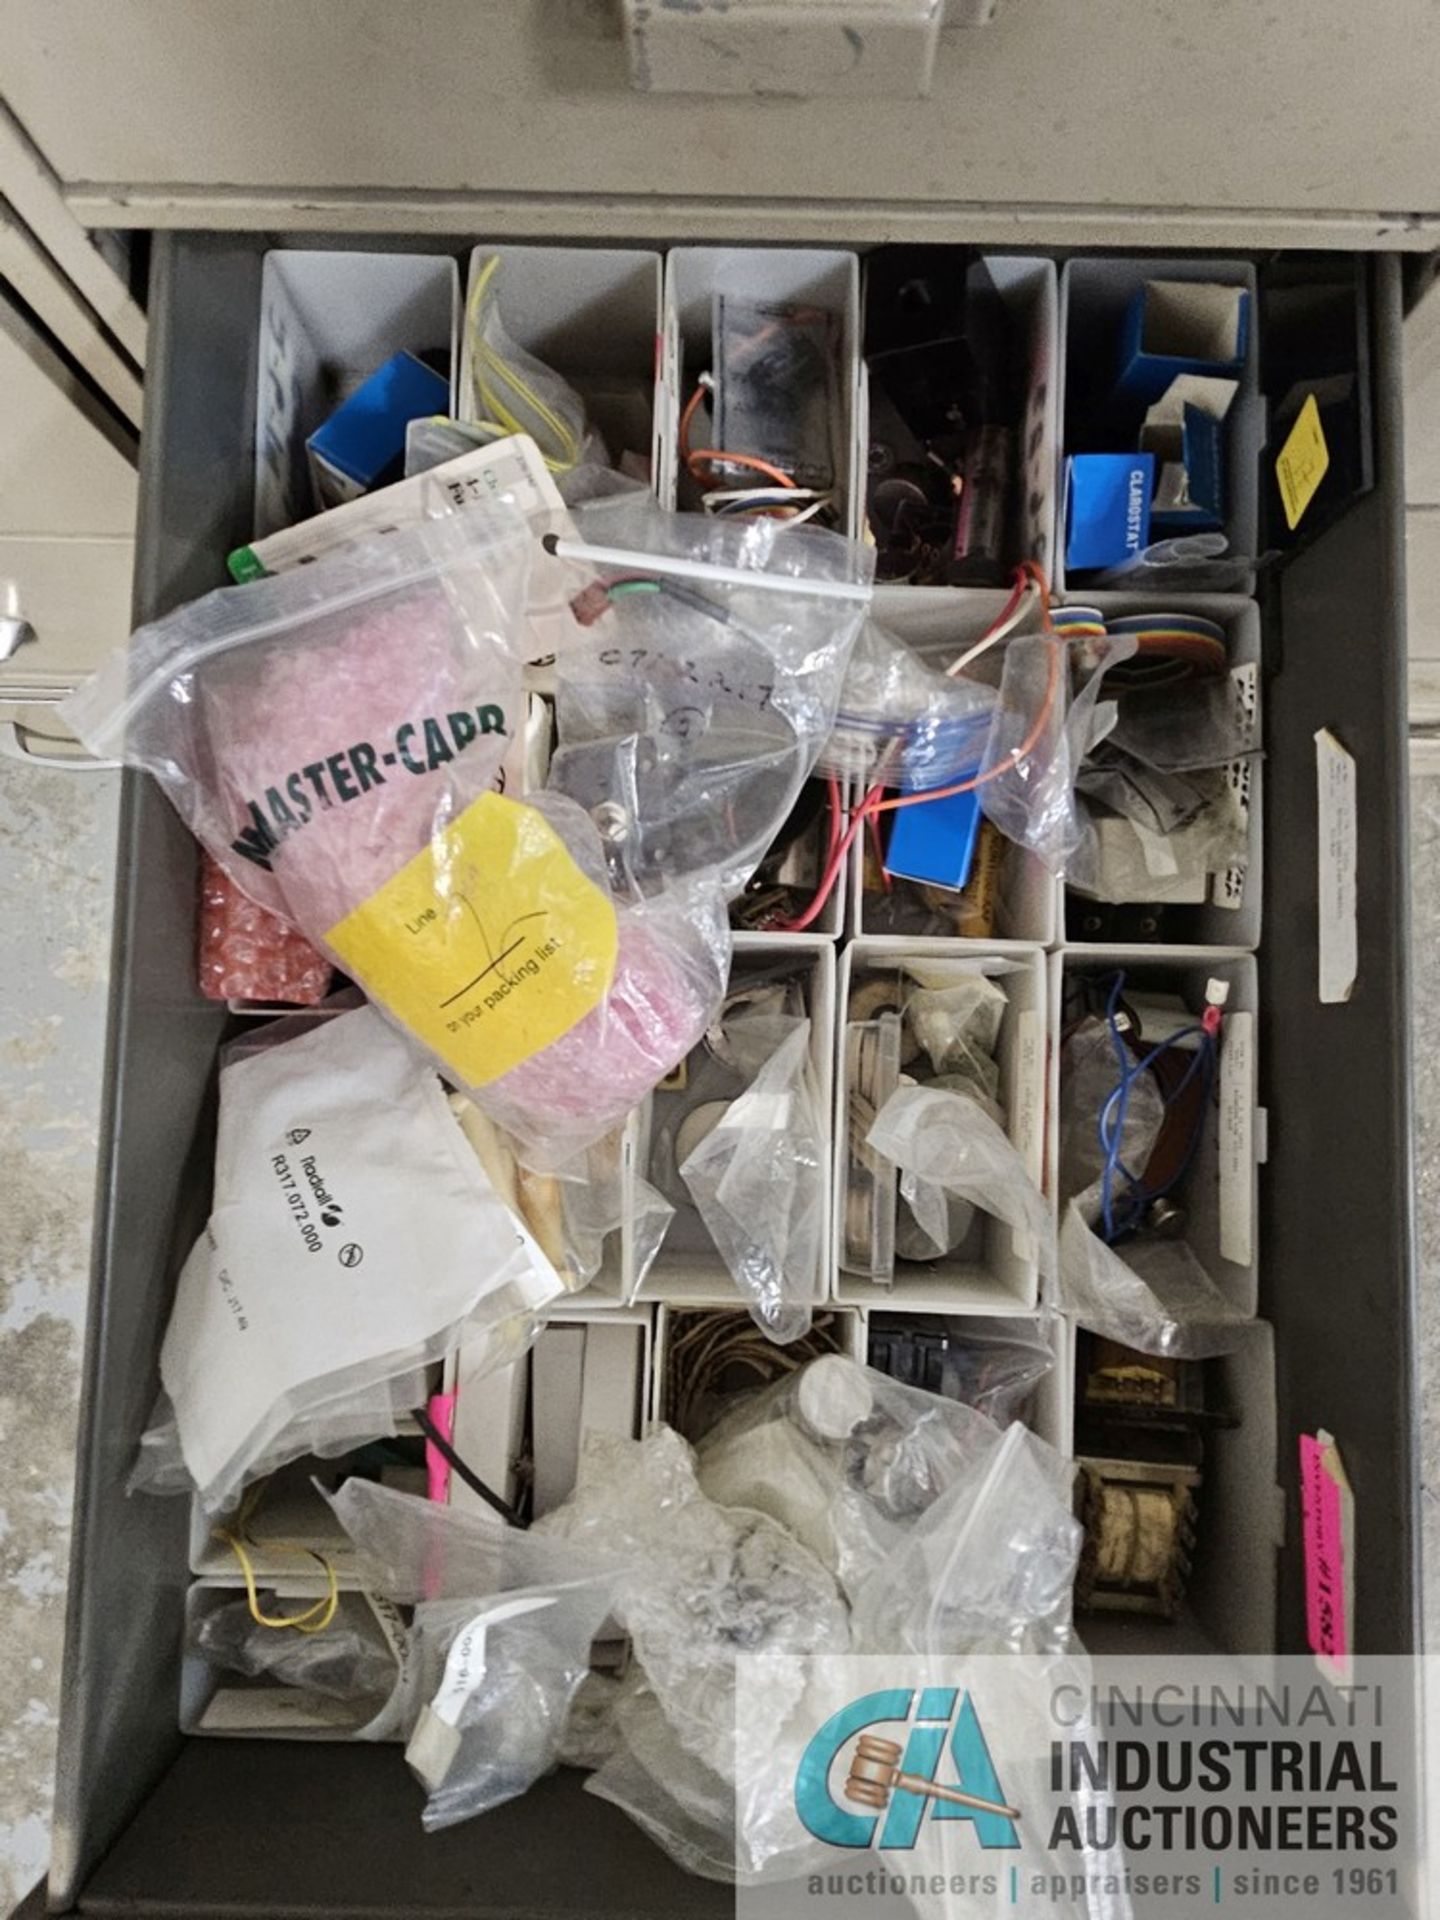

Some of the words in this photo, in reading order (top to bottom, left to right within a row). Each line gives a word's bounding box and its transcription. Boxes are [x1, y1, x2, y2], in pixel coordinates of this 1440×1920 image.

[1126, 470, 1144, 550] CLAROSTAT
[404, 908, 437, 935] Line
[484, 959, 540, 1010] packing
[534, 937, 563, 961] list
[271, 1154, 323, 1252] R317.072.000
[300, 1155, 334, 1206] Radiall
